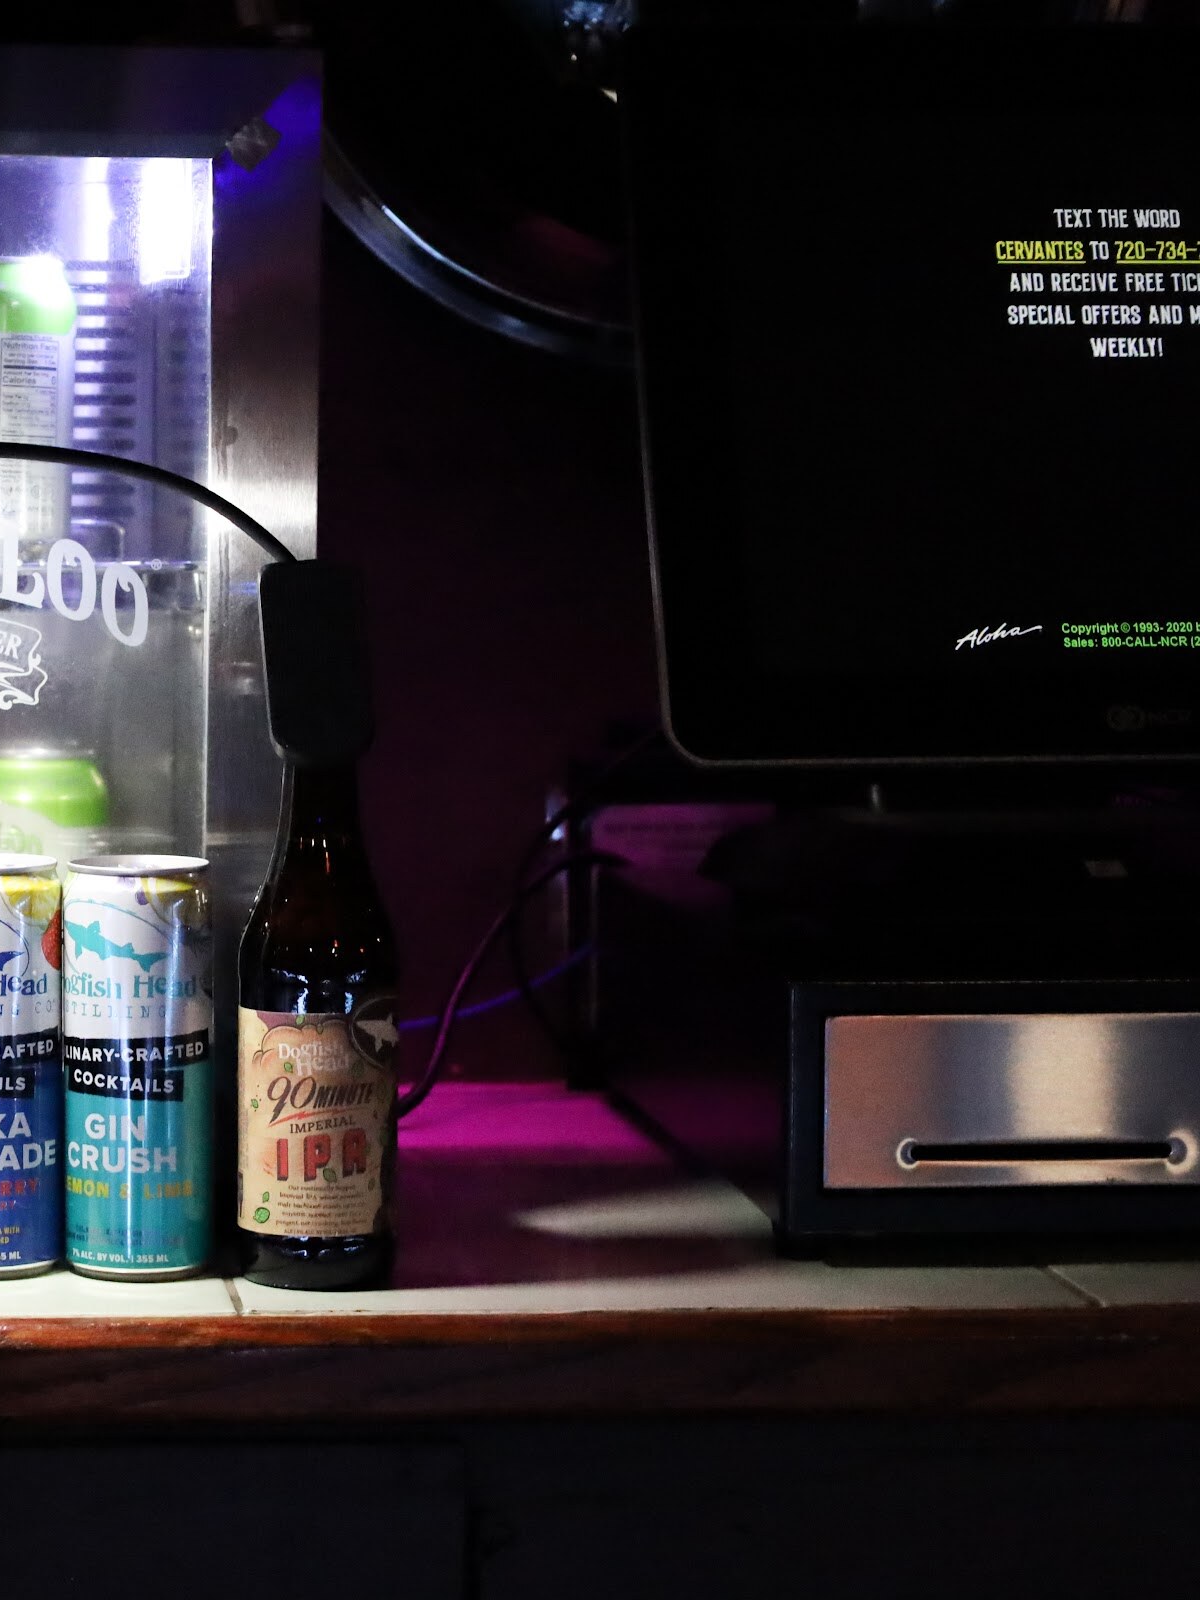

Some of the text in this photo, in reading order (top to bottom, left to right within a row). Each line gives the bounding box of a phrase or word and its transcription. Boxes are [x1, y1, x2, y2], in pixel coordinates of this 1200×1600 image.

[1052, 208, 1181, 228] TEXT THE WORD
[995, 240, 1200, 261] CERVANTES TO 720-734-
[1009, 272, 1044, 292] AND
[1050, 272, 1119, 292] RECEIVE
[1124, 272, 1166, 292] FREE
[1006, 304, 1183, 325] SPECIAL OFFERS AND
[1089, 336, 1163, 357] WEEKLY!
[955, 622, 1043, 650] Aloha
[1061, 622, 1120, 635] Copyright
[1132, 622, 1164, 633] 1993-
[1166, 622, 1193, 633] 2020
[1063, 636, 1188, 648] Sales: 800-CALL-NCR
[133, 974, 196, 999] Head
[277, 1040, 347, 1061] Dogfish
[296, 1053, 349, 1077] Head
[73, 1068, 175, 1094] COCKTAILS
[267, 1076, 374, 1123] 90 MINUTE
[84, 1112, 146, 1142] GIN
[289, 1115, 356, 1134] IMPERIAL
[67, 1141, 178, 1174] CRUSH
[4, 1225, 20, 1235] WITH
[8, 1251, 22, 1260] ML
[80, 1251, 96, 1261] ALC.
[97, 1252, 107, 1261] BY
[109, 1253, 128, 1263] VOL.
[135, 1254, 155, 1263] 355
[156, 1253, 169, 1263] ML
